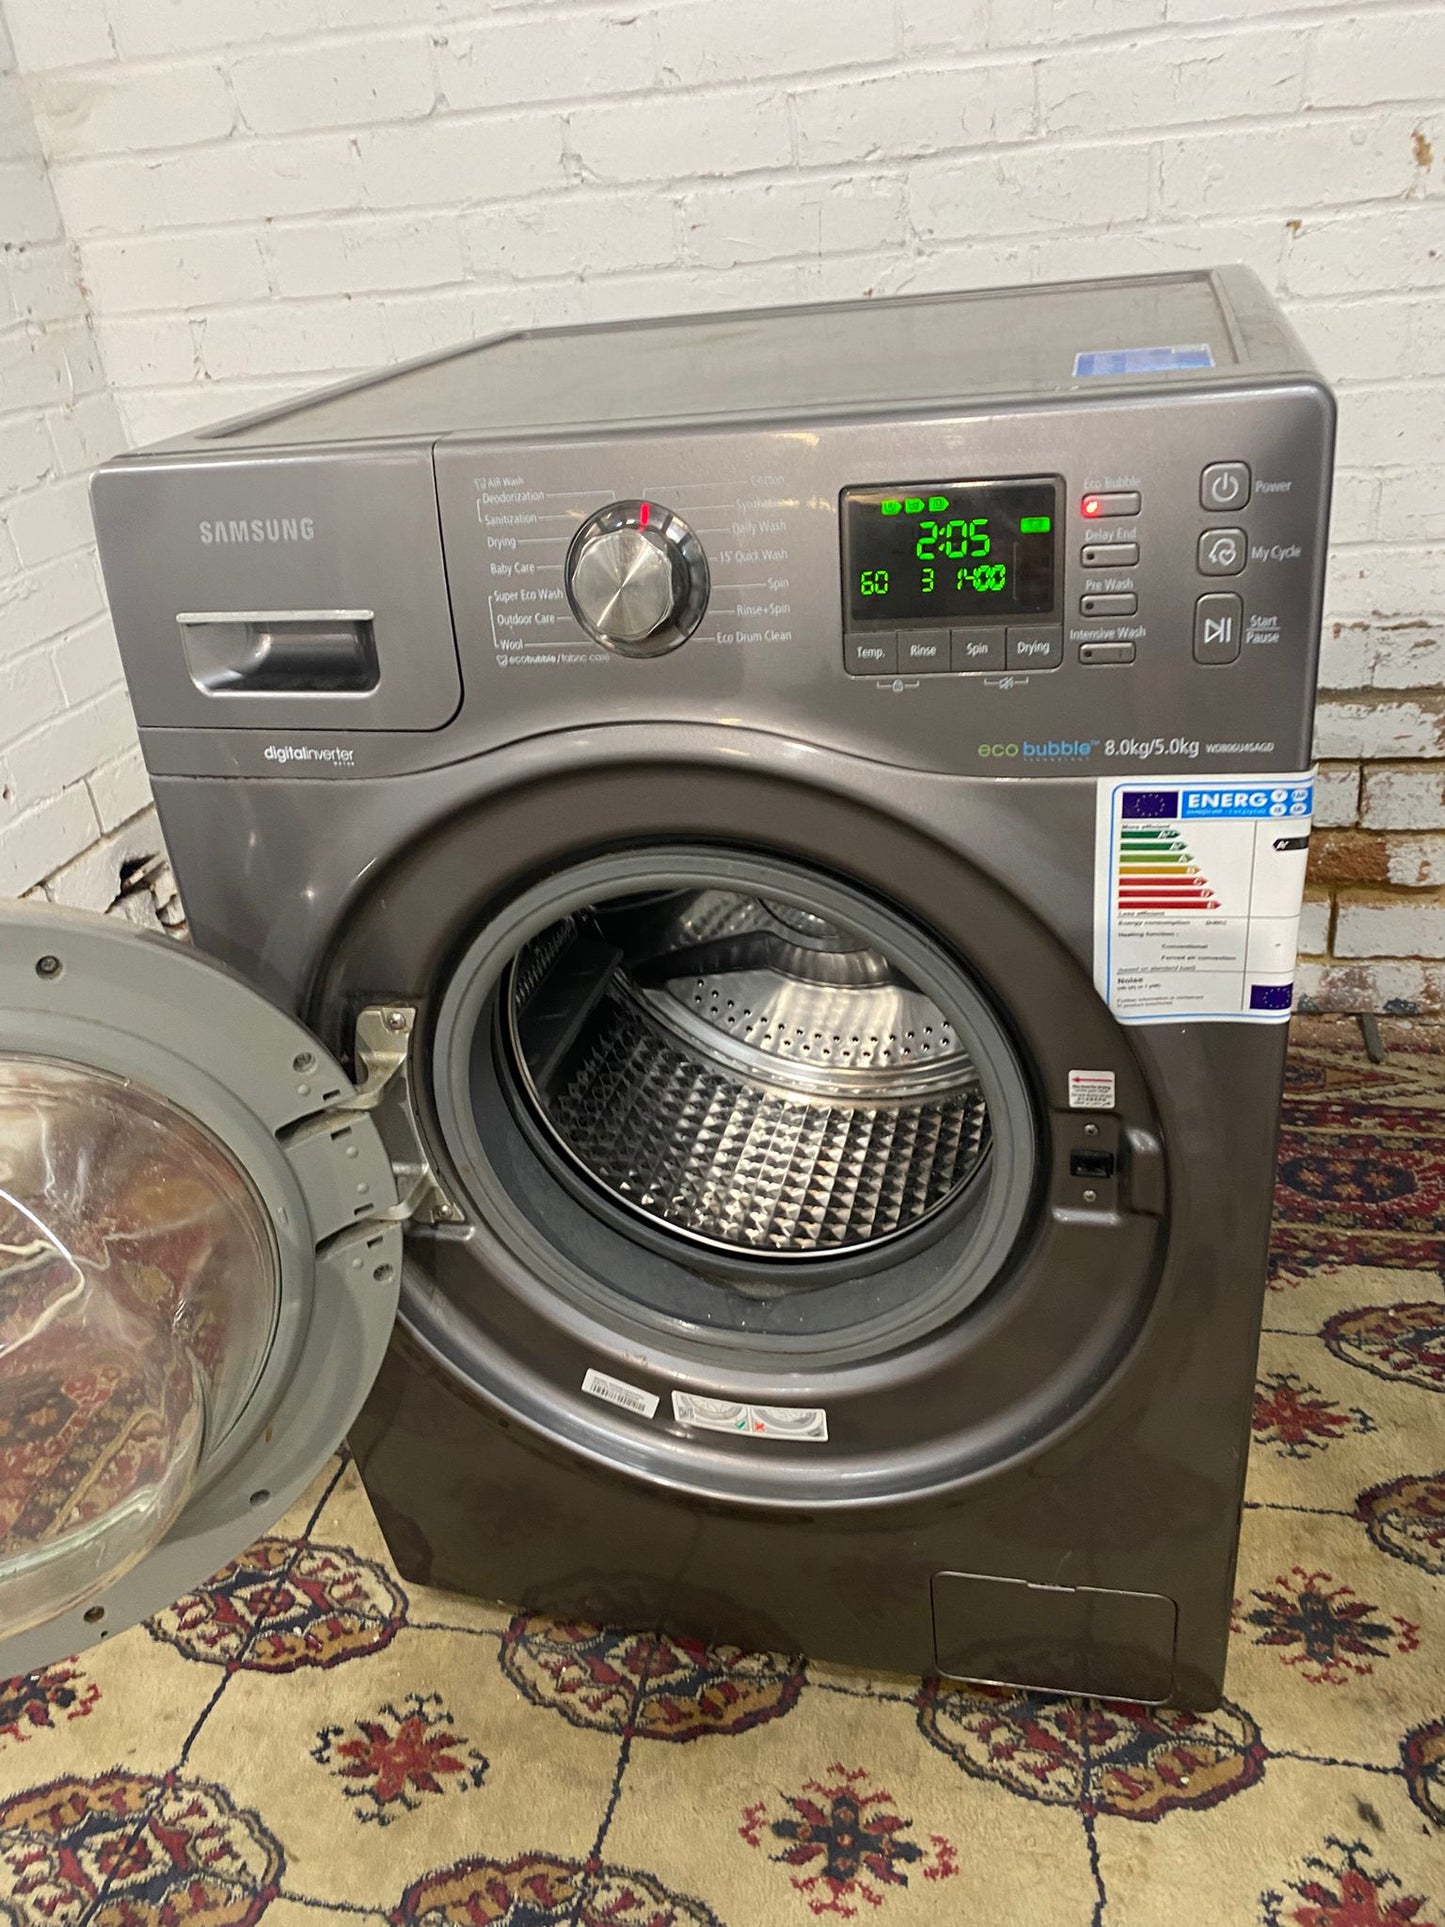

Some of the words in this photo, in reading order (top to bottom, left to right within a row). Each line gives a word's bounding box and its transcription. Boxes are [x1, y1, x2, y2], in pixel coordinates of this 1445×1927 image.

[1084, 479, 1101, 489] Eco
[1105, 476, 1142, 488] Bubble
[1255, 480, 1292, 492] Power
[482, 490, 544, 504] Deodorization
[485, 512, 537, 526] Sanitization
[759, 520, 786, 532] Wash
[200, 518, 314, 544] SAMSUNG
[1086, 529, 1114, 542] Delay
[1117, 528, 1136, 539] End
[487, 536, 516, 550] Drying
[916, 518, 990, 560] 2:05
[735, 550, 760, 563] Quick
[762, 548, 788, 560] Wash
[1252, 546, 1269, 562] My
[1270, 545, 1302, 561] Cycle
[490, 563, 512, 576] Baby
[514, 562, 534, 573] Care
[768, 578, 789, 590] Spin
[860, 570, 888, 595] 60
[922, 568, 934, 592] 3
[956, 564, 1006, 592] 1400
[1086, 580, 1101, 590] Pre
[1105, 578, 1134, 590] Wash
[494, 590, 518, 604] Super
[520, 590, 536, 600] Eco
[538, 588, 564, 600] Wash
[737, 602, 790, 616] Rinse+Spin
[497, 614, 532, 625] Outdoor
[534, 613, 555, 623] Care
[1250, 615, 1278, 627] Start
[716, 632, 734, 644] Eco
[736, 631, 762, 642] Drum
[765, 629, 792, 640] Clean
[1070, 629, 1115, 640] Intensive
[1118, 626, 1146, 638] Wash
[1246, 632, 1280, 644] Pause
[500, 640, 524, 650] Wool
[910, 645, 936, 656] Rinse
[966, 642, 988, 656] Spin
[1018, 640, 1050, 656] Drying
[858, 646, 885, 662] Temp.
[978, 742, 1018, 758] eco
[1104, 738, 1200, 759] 8.0kg/5.0kg
[1188, 793, 1268, 808] ENERG
